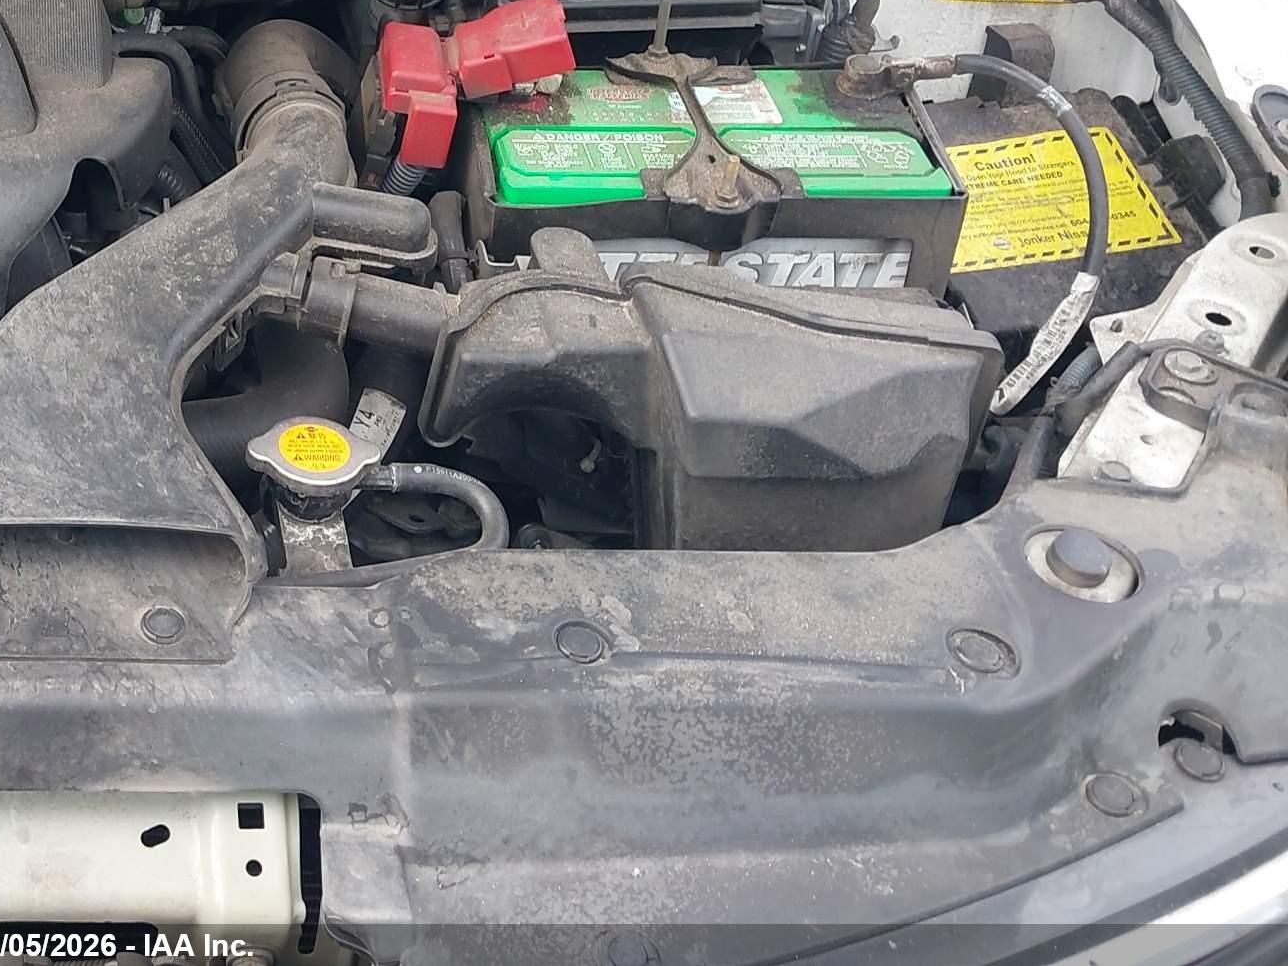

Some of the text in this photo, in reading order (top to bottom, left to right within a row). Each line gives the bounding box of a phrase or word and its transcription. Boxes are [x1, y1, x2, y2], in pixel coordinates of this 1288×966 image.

[614, 133, 664, 144] POISON
[974, 153, 1036, 172] Caution!
[1001, 177, 1026, 186] CARE
[1027, 171, 1063, 183] NEEDED
